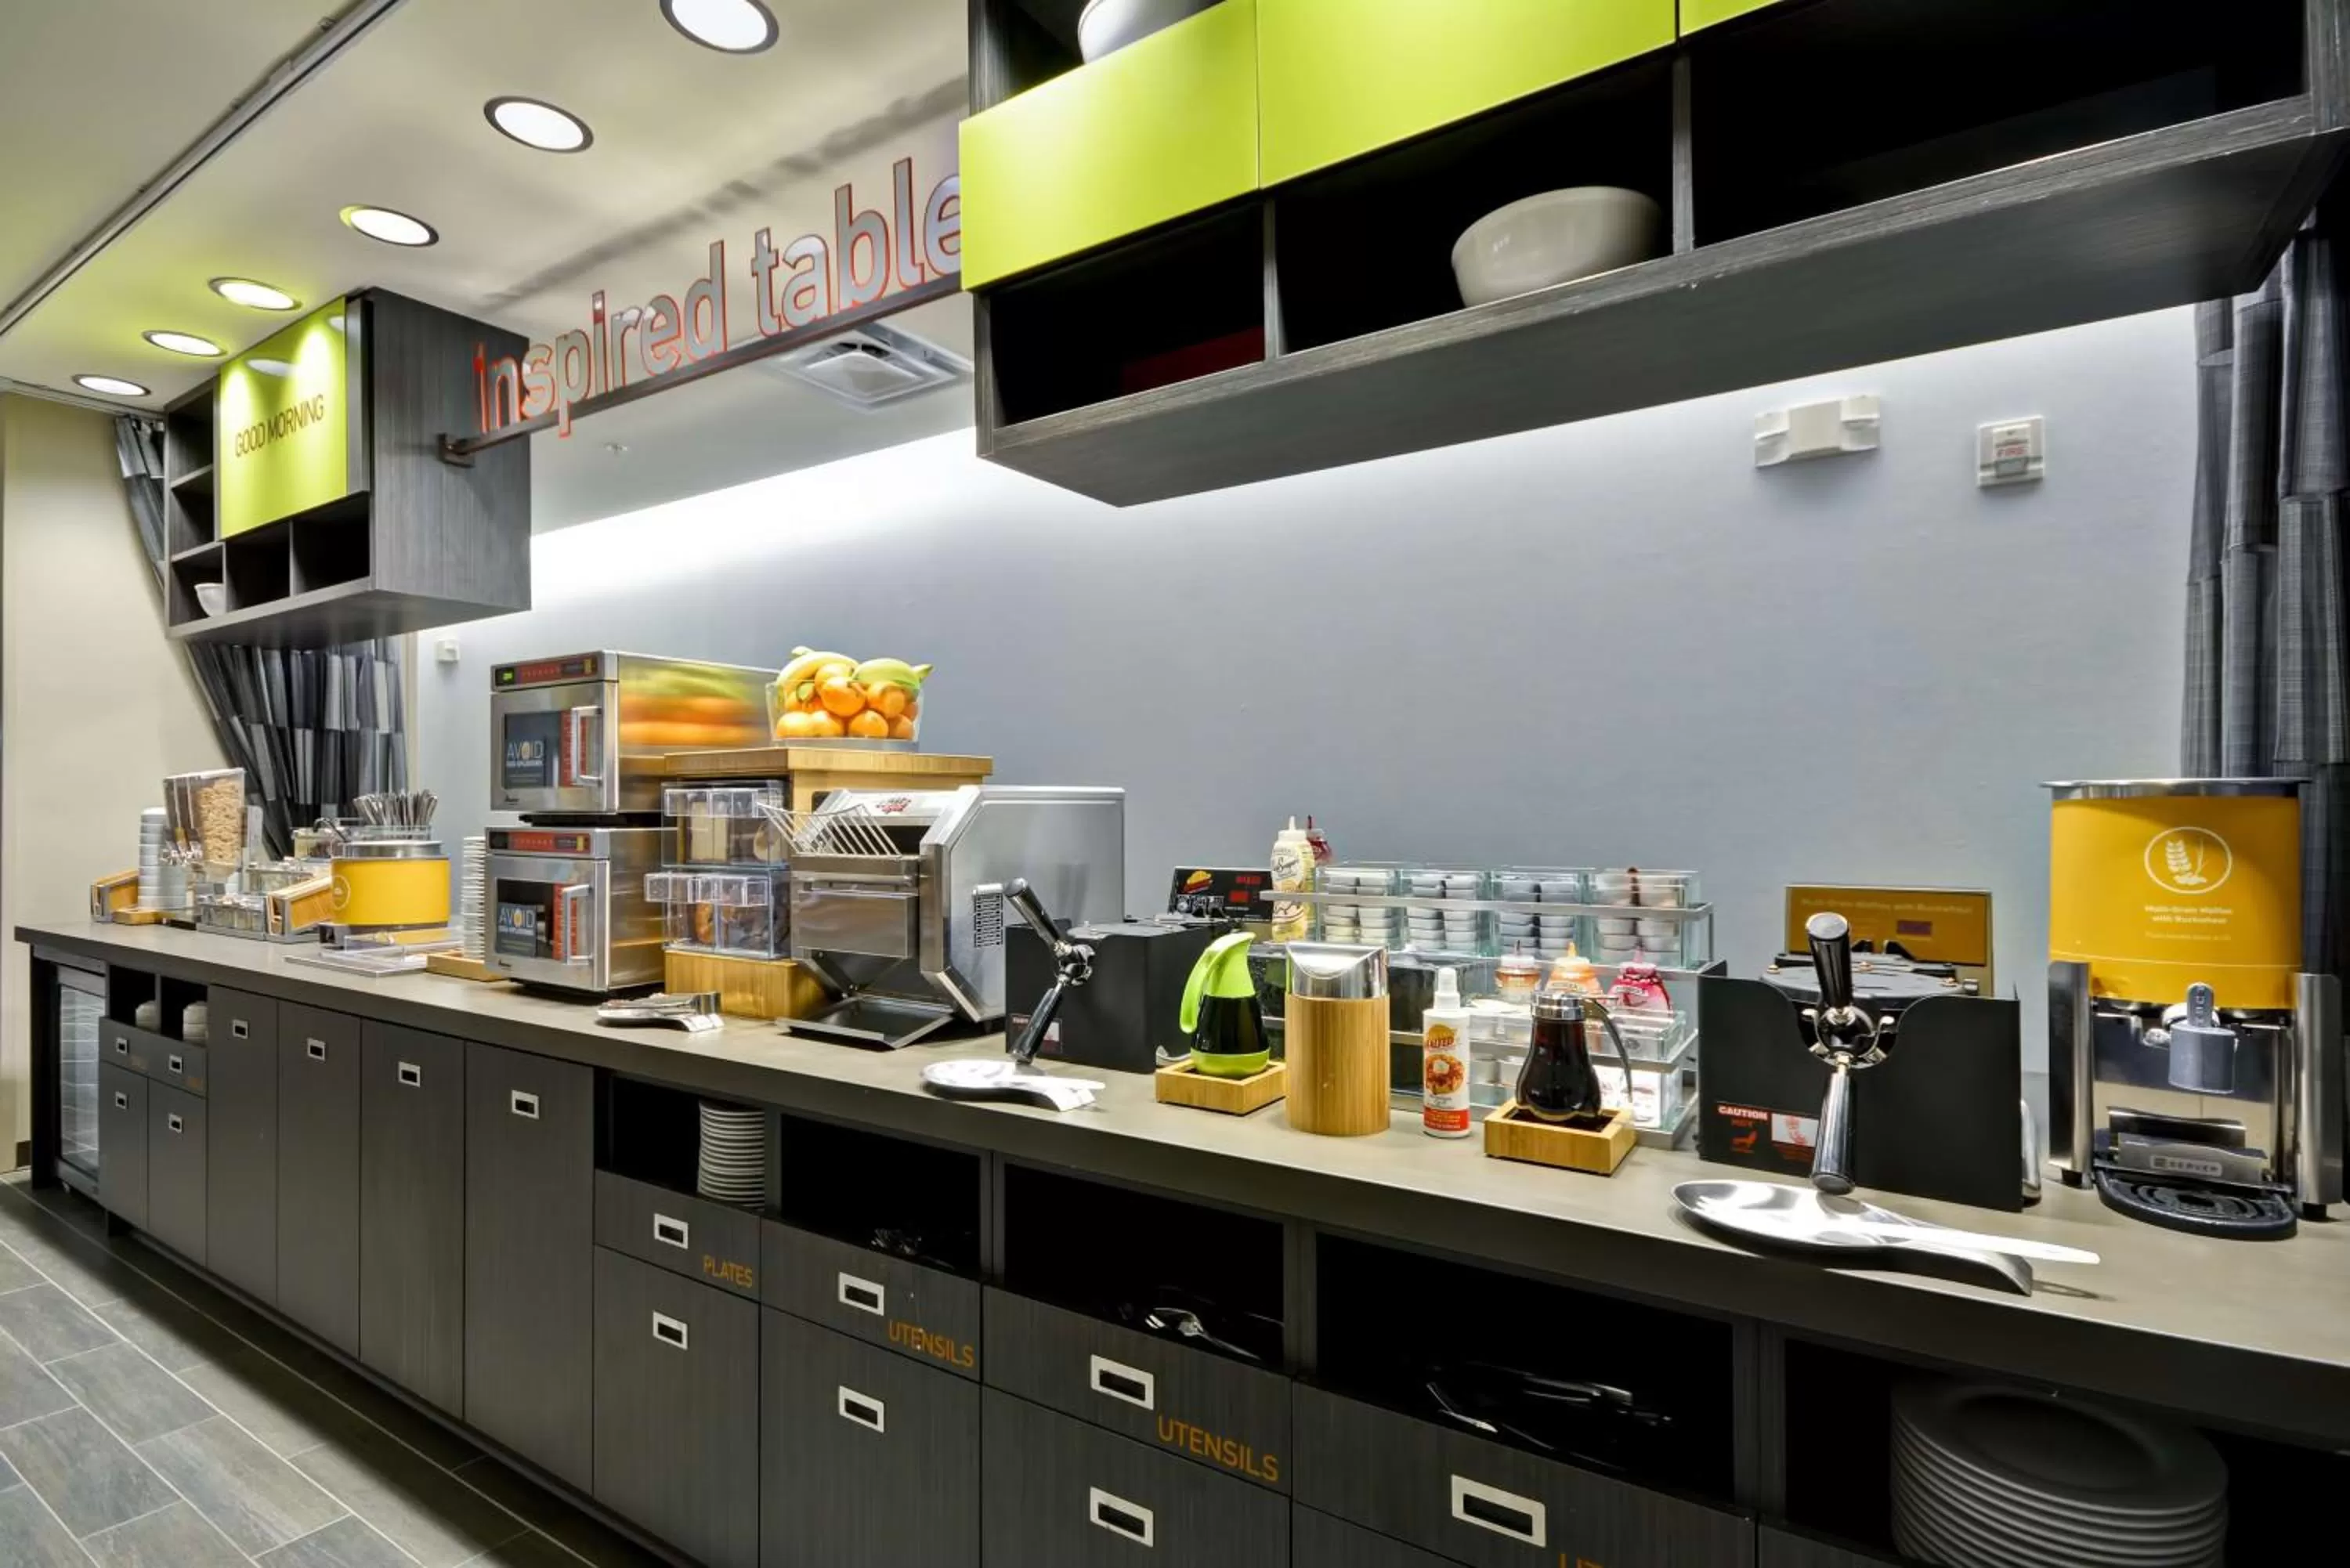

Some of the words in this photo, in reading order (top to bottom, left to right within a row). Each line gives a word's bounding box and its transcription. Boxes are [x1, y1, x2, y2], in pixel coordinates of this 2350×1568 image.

[473, 239, 728, 440] inspired
[235, 421, 266, 457] GOOD
[267, 393, 324, 444] MORNING
[507, 740, 544, 761] AVOID
[498, 907, 536, 929] AVOID
[1718, 1105, 1768, 1121] CAUTION
[703, 1255, 753, 1288] PLATES
[889, 1319, 974, 1367] UTENSILS
[1159, 1415, 1280, 1482] UTENSILS
